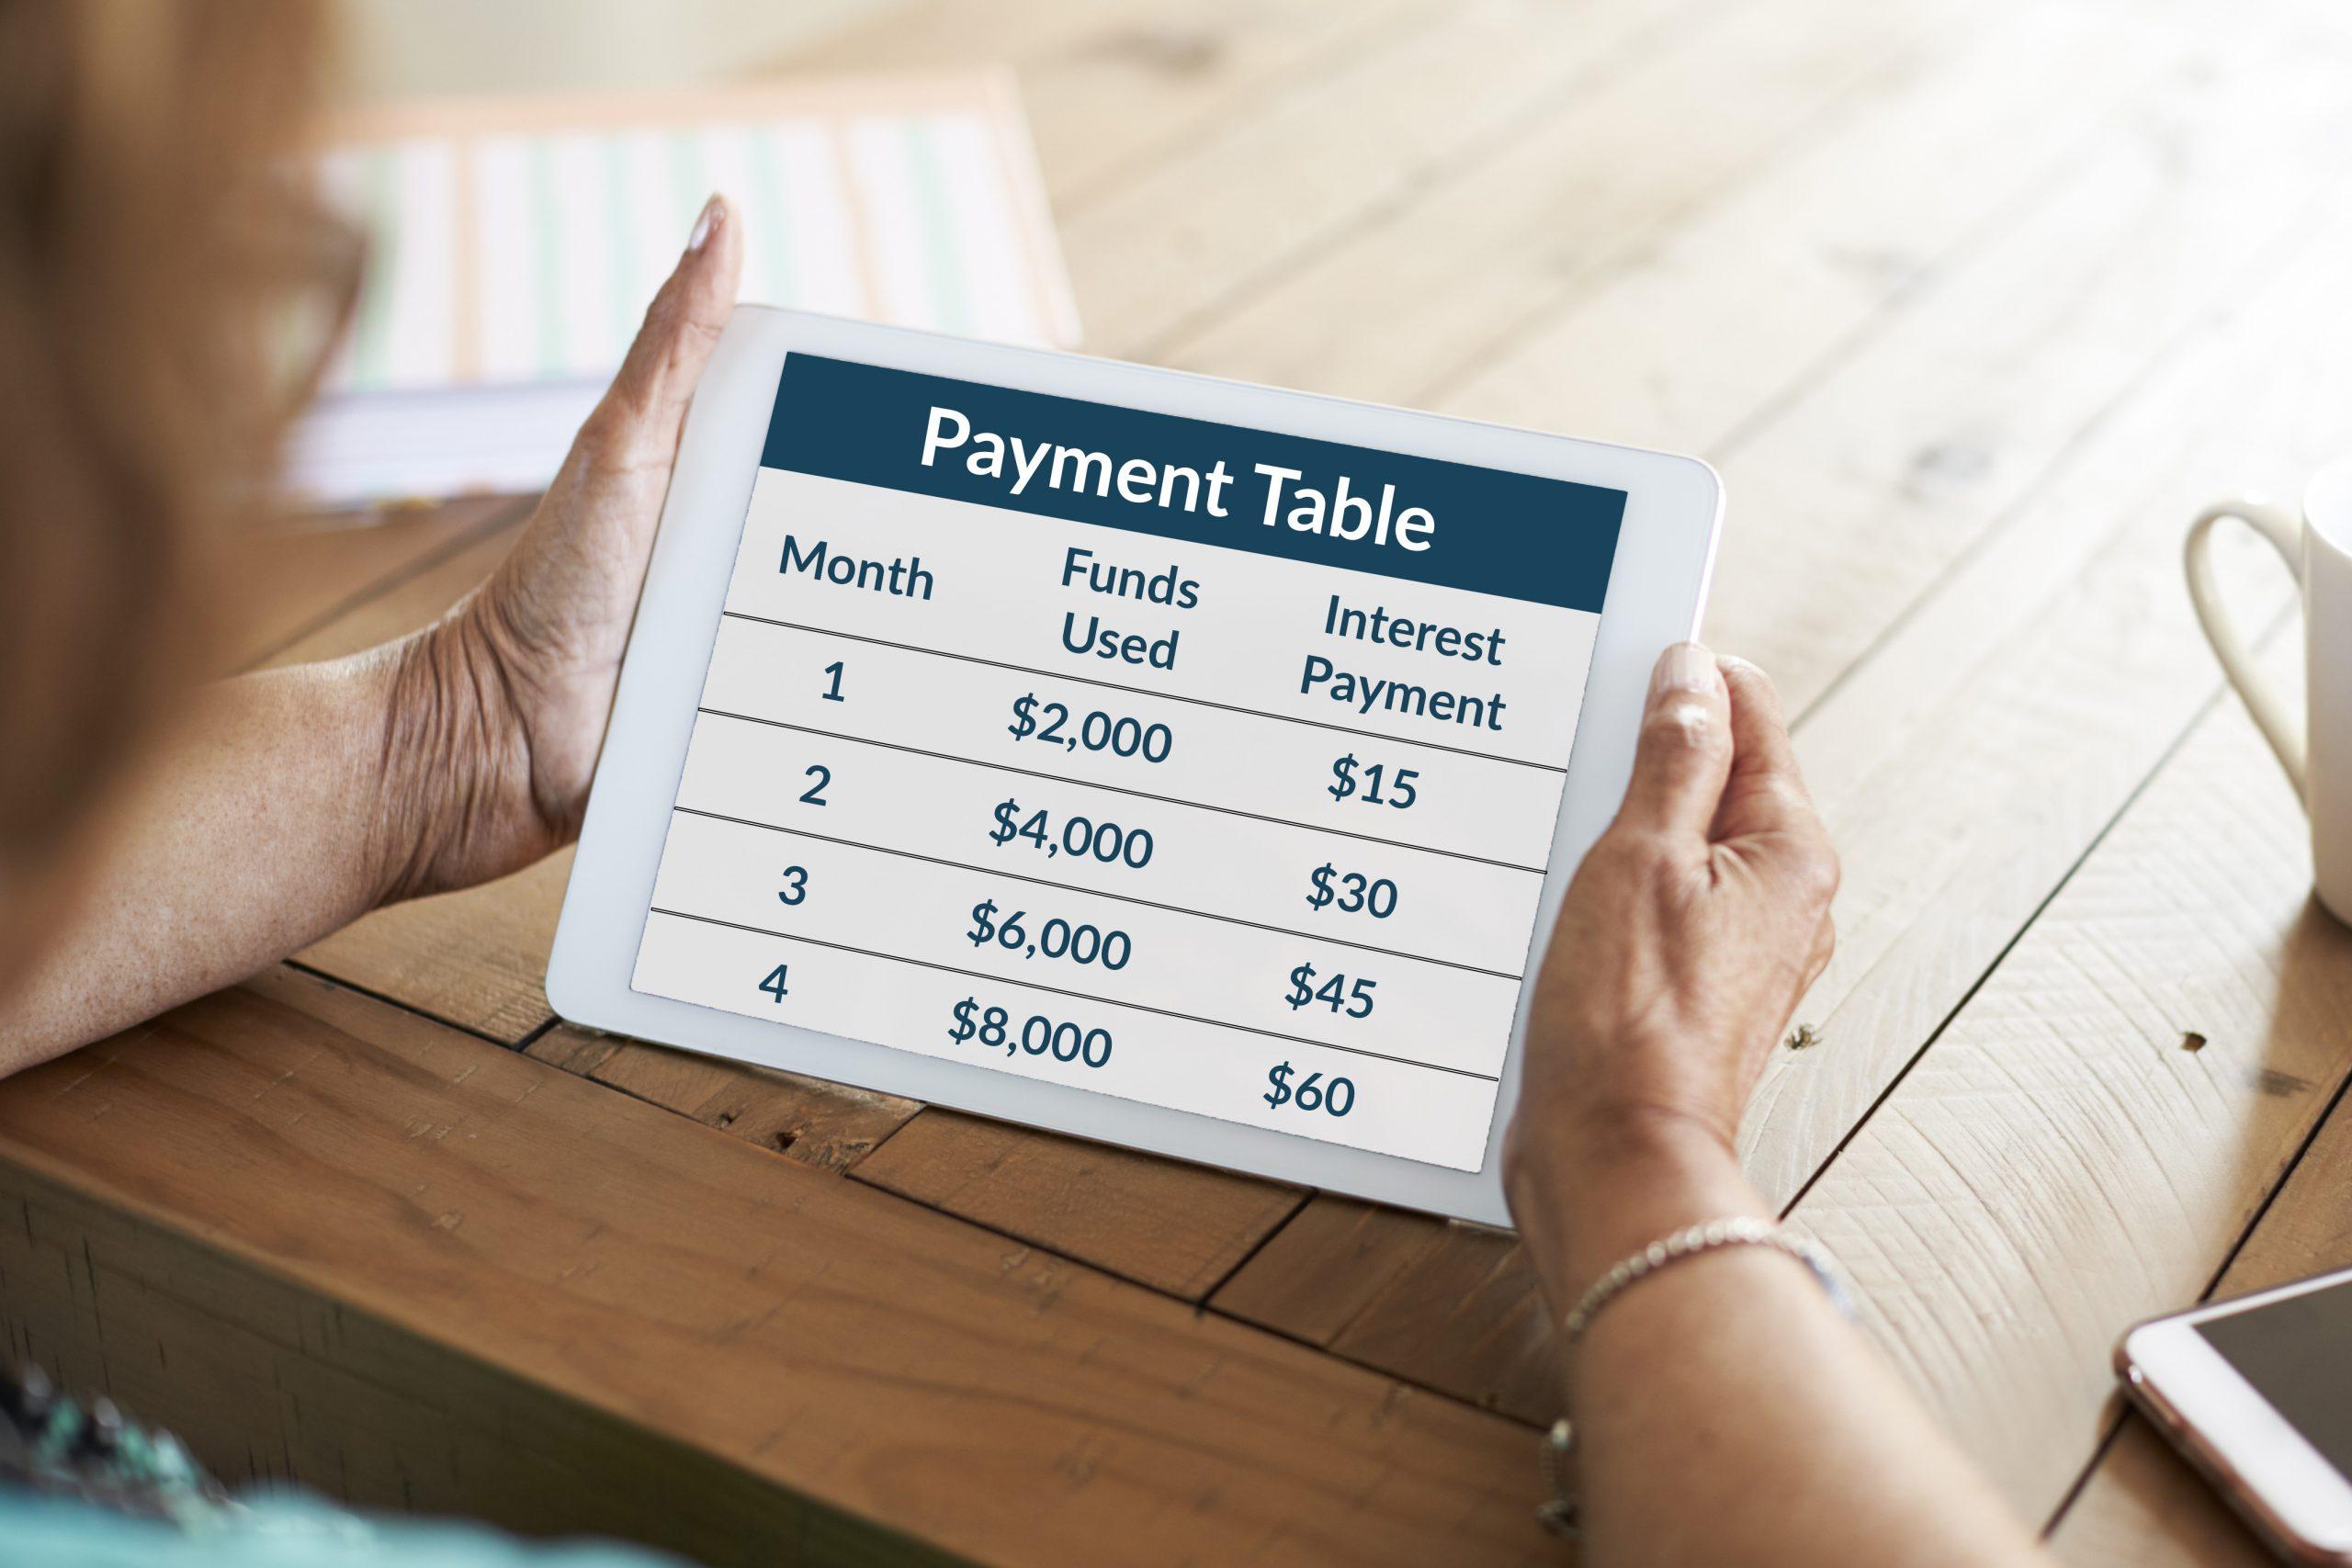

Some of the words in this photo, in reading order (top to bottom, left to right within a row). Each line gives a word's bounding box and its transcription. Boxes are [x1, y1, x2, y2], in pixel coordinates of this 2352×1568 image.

[921, 406, 1234, 518] Payment
[1254, 462, 1435, 552] Table
[778, 534, 933, 601] Month
[1061, 547, 1200, 609] Funds
[1062, 612, 1180, 671] Used
[1325, 594, 1506, 666] Interest
[822, 660, 844, 703] 1
[1300, 654, 1507, 731] Payment
[1007, 693, 1172, 763] $2,000
[798, 764, 831, 807] 2
[1327, 754, 1419, 809] $15
[989, 798, 1154, 869] $4,000
[778, 865, 808, 906] 3
[1306, 862, 1397, 919] $30
[967, 898, 1132, 971] $6,000
[758, 964, 788, 1004] 4
[1284, 962, 1377, 1019] $45
[947, 996, 1113, 1068] $8,000
[1263, 1061, 1355, 1117] $60
